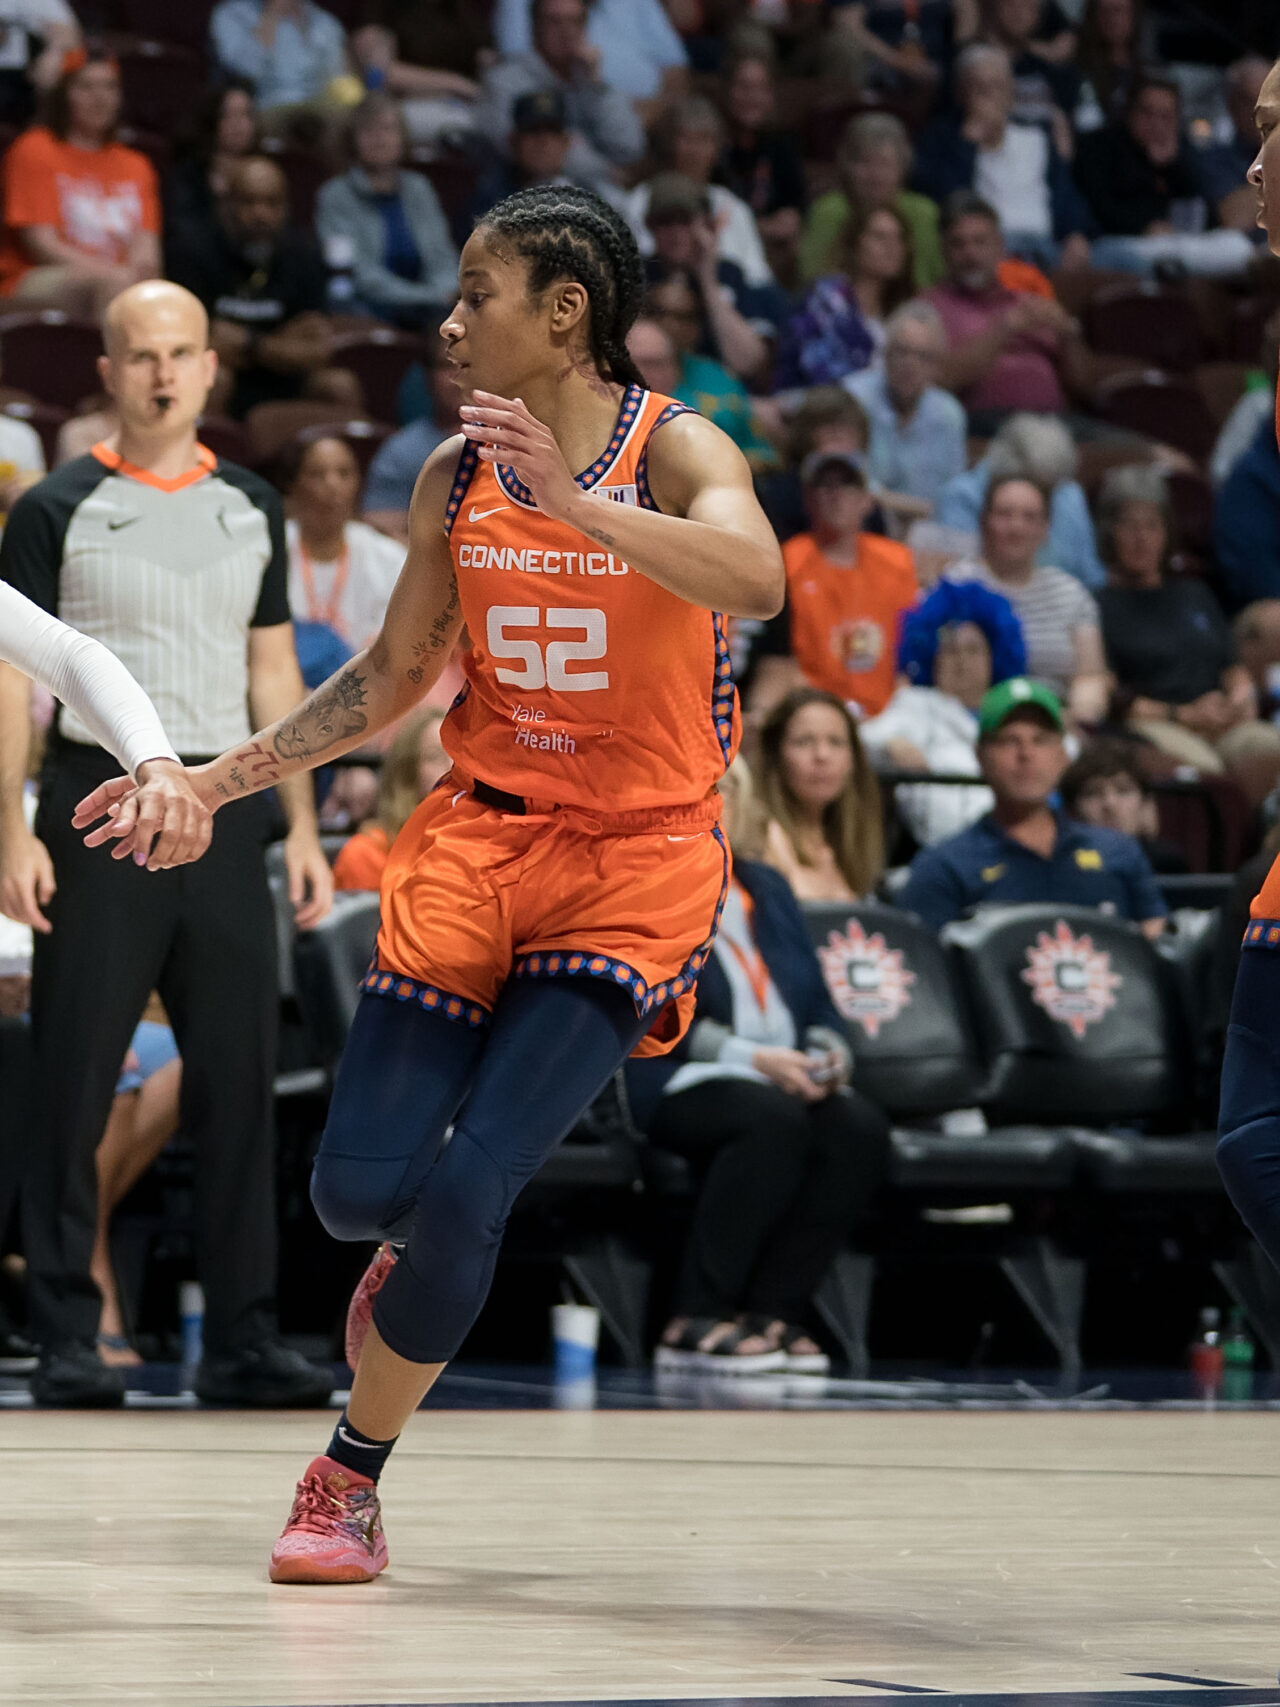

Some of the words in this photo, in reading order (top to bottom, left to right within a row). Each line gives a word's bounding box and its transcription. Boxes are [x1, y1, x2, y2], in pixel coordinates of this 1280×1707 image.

[458, 544, 641, 576] CONNECTICU
[486, 605, 609, 692] 52
[511, 703, 546, 723] Yale
[515, 729, 576, 754] Health
